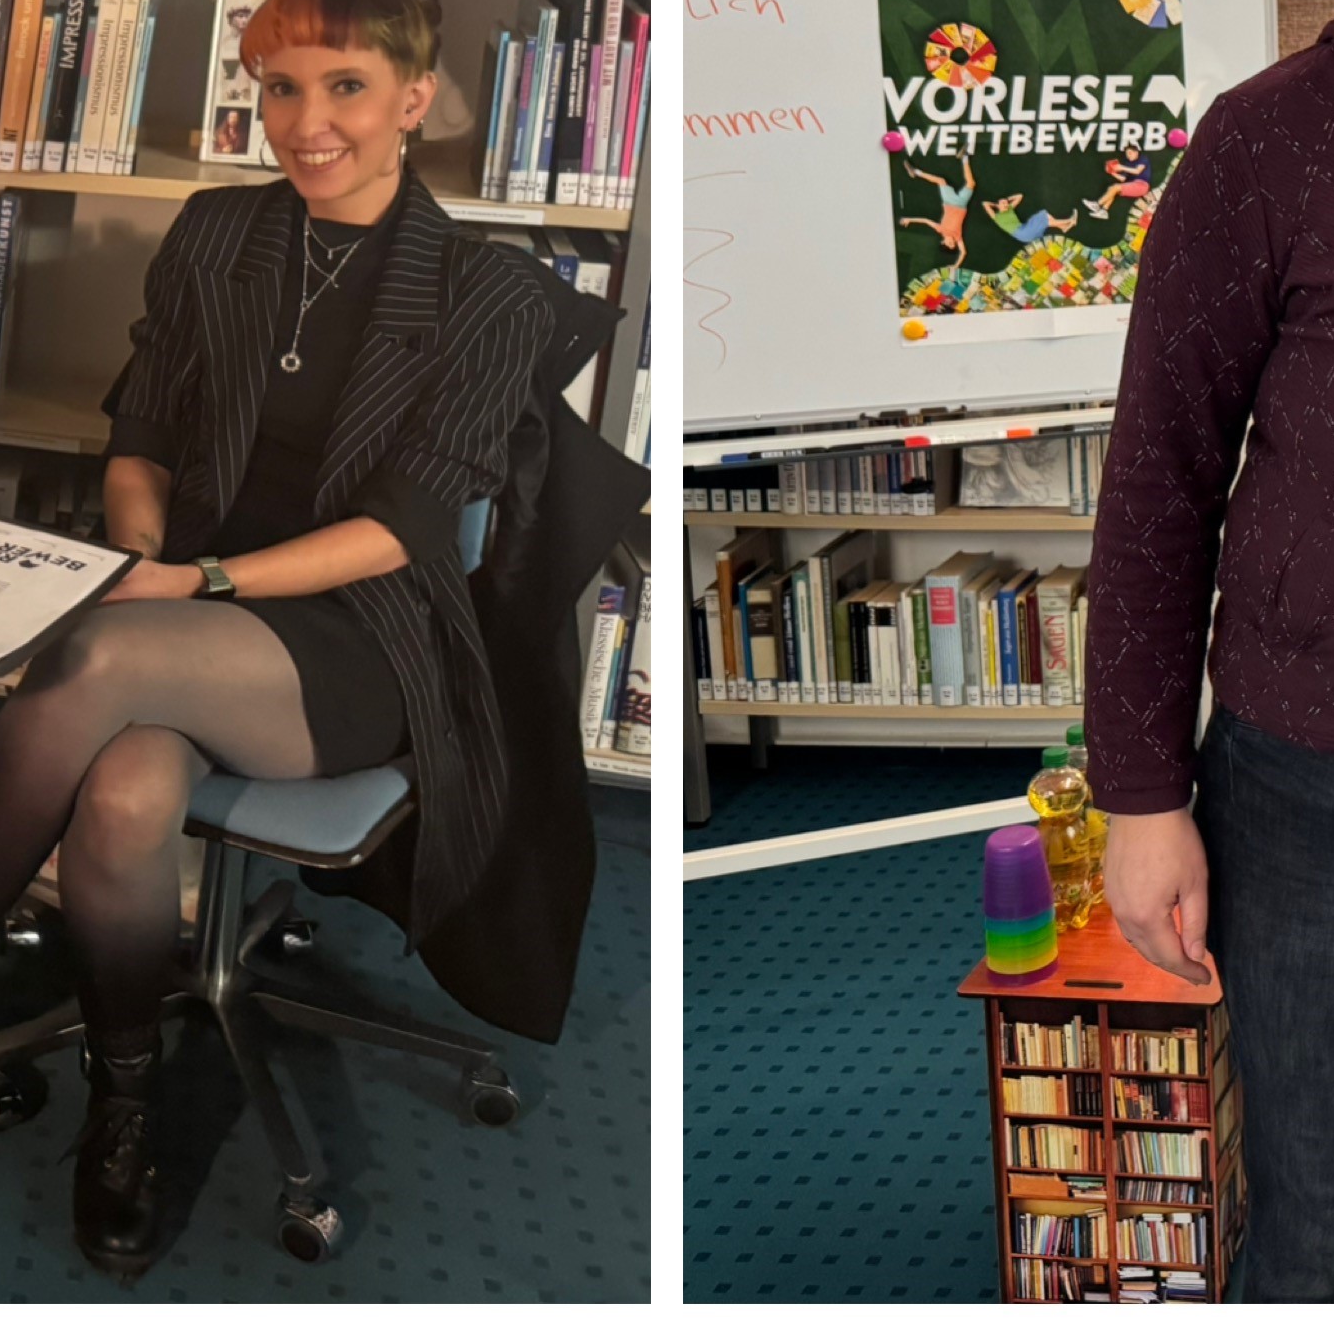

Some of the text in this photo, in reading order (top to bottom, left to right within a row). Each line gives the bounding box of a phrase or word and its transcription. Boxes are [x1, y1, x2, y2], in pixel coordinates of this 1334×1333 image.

[90, 19, 114, 116] Impressionismus
[110, 19, 134, 117] Impressionismus
[883, 74, 1134, 124] VORLESE
[898, 121, 1168, 158] WETTBEWERB
[588, 616, 615, 683] Klassische
[1044, 613, 1068, 670] SAGEN
